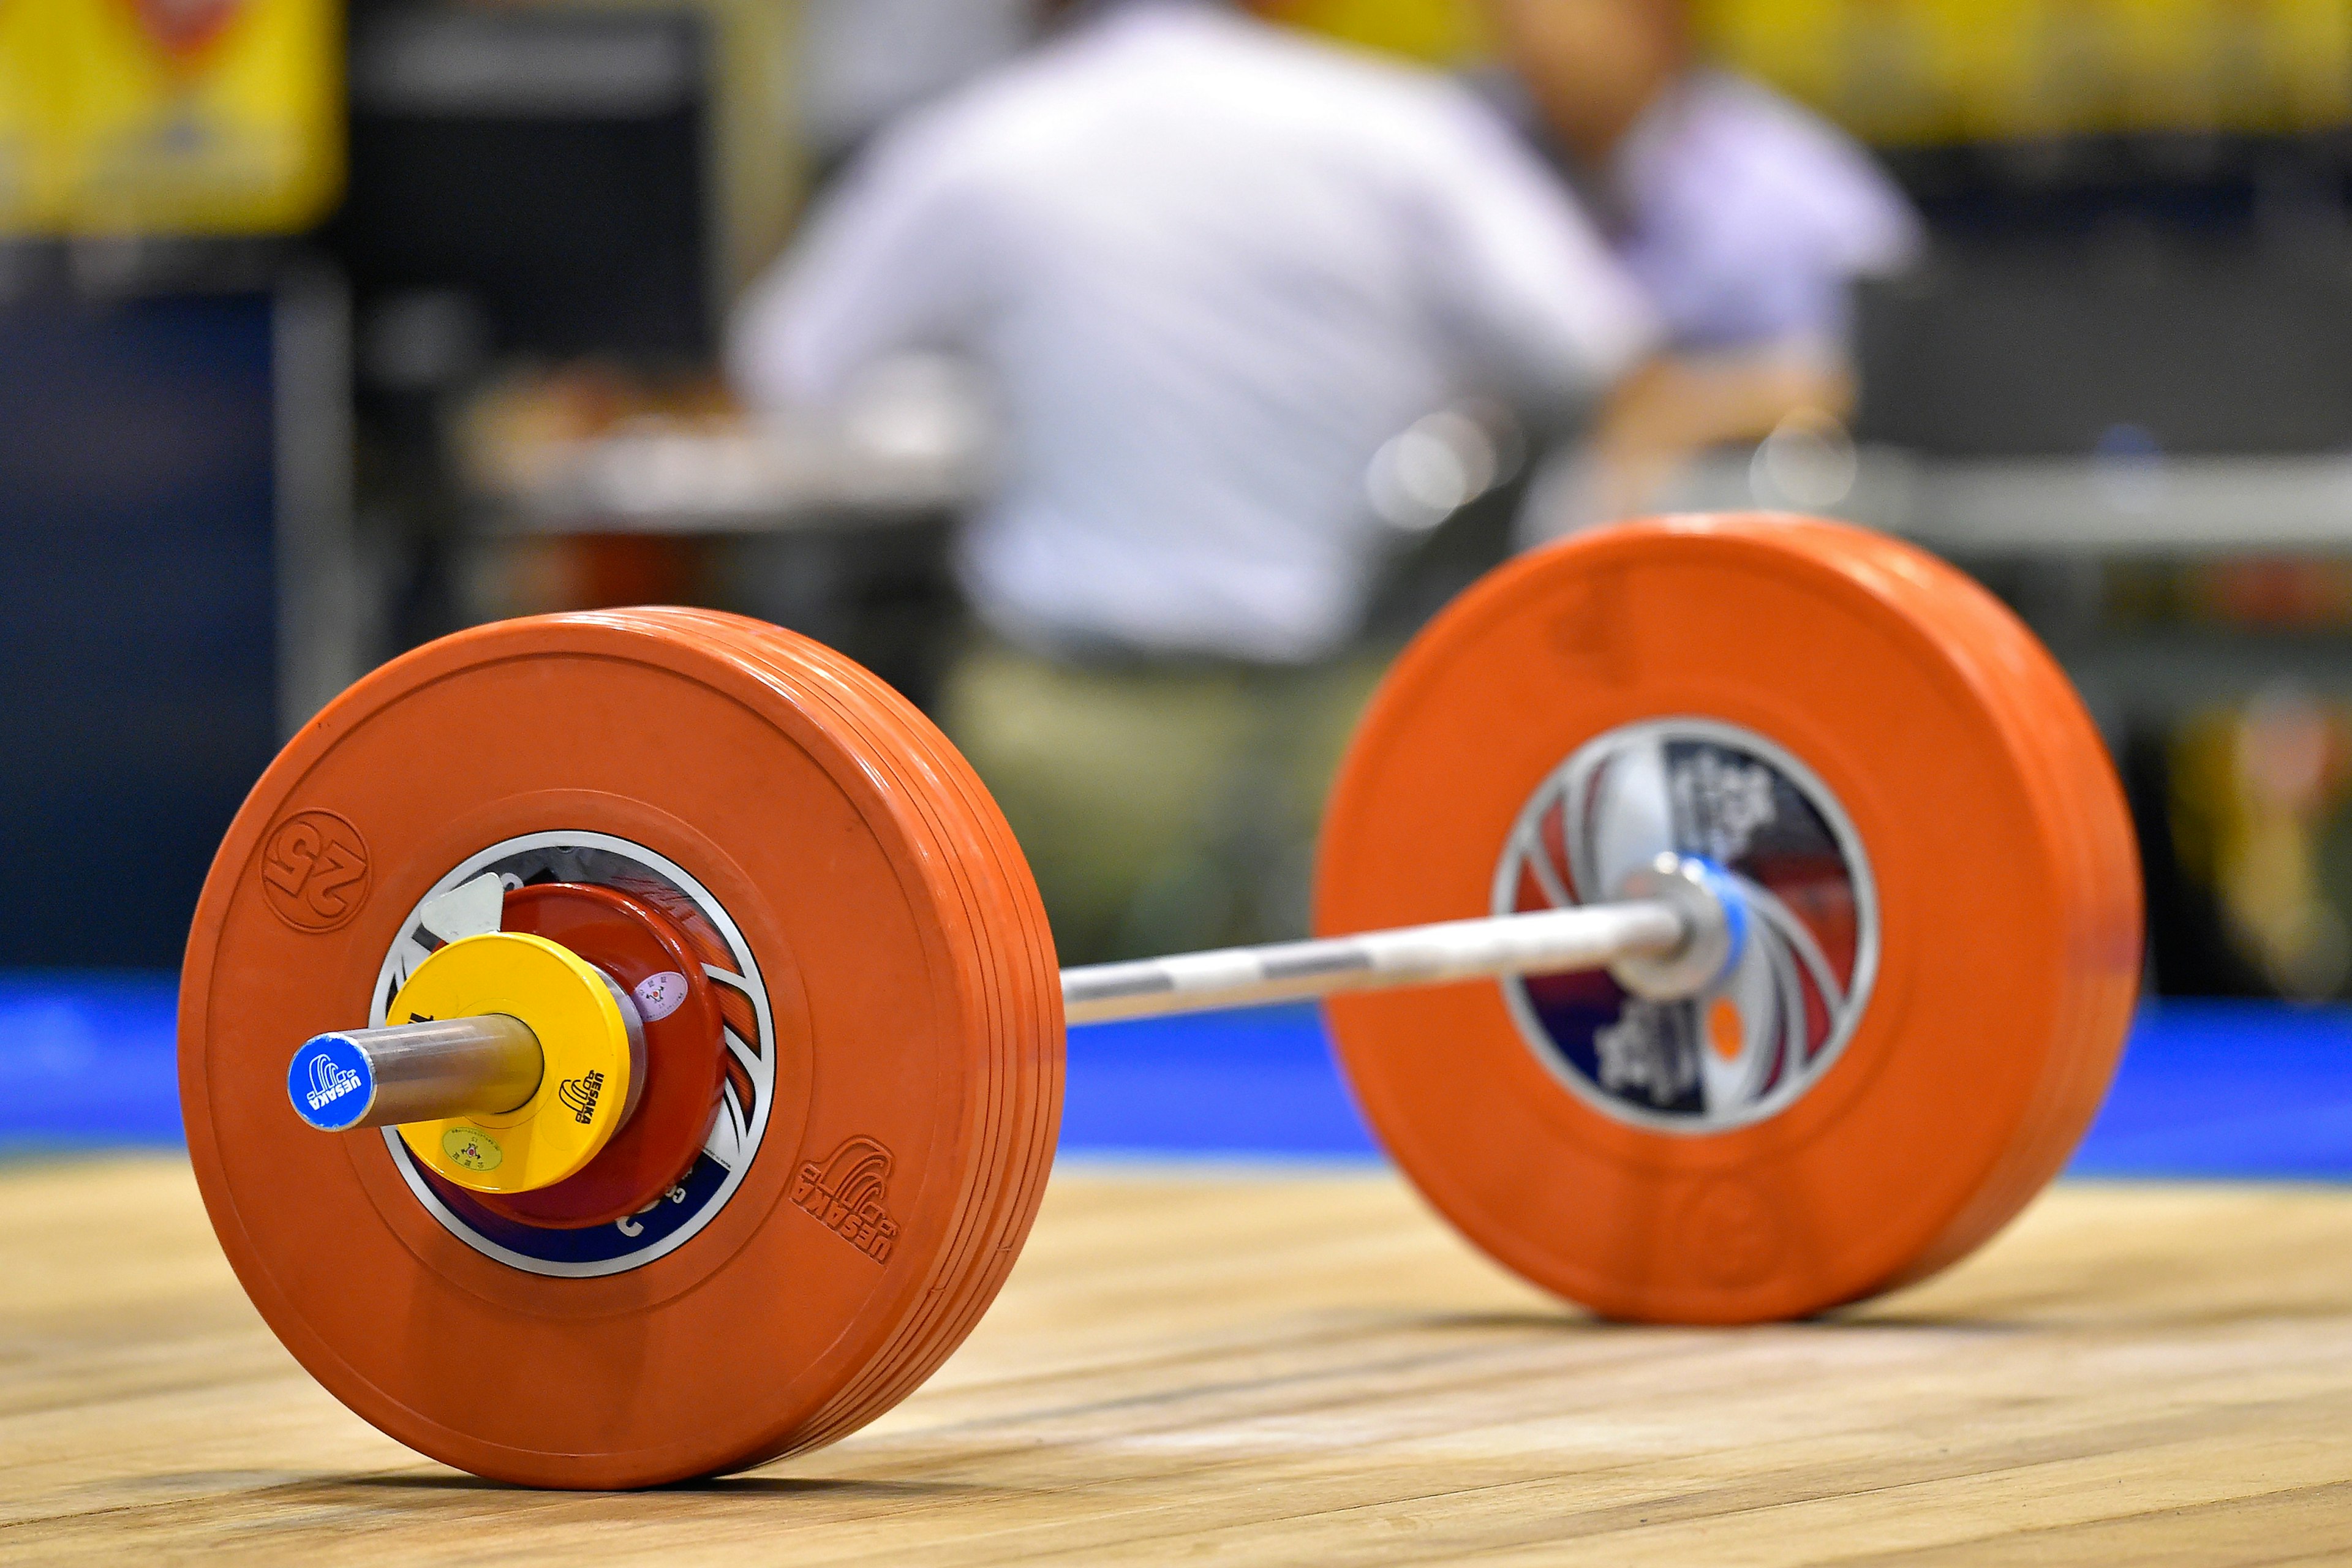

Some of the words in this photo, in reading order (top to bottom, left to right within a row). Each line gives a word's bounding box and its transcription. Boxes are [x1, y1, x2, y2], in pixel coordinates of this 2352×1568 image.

[263, 820, 368, 919] 25
[308, 1075, 362, 1111] UESAKA
[581, 1072, 605, 1125] UESAKA
[791, 1174, 892, 1265] UESAKA
